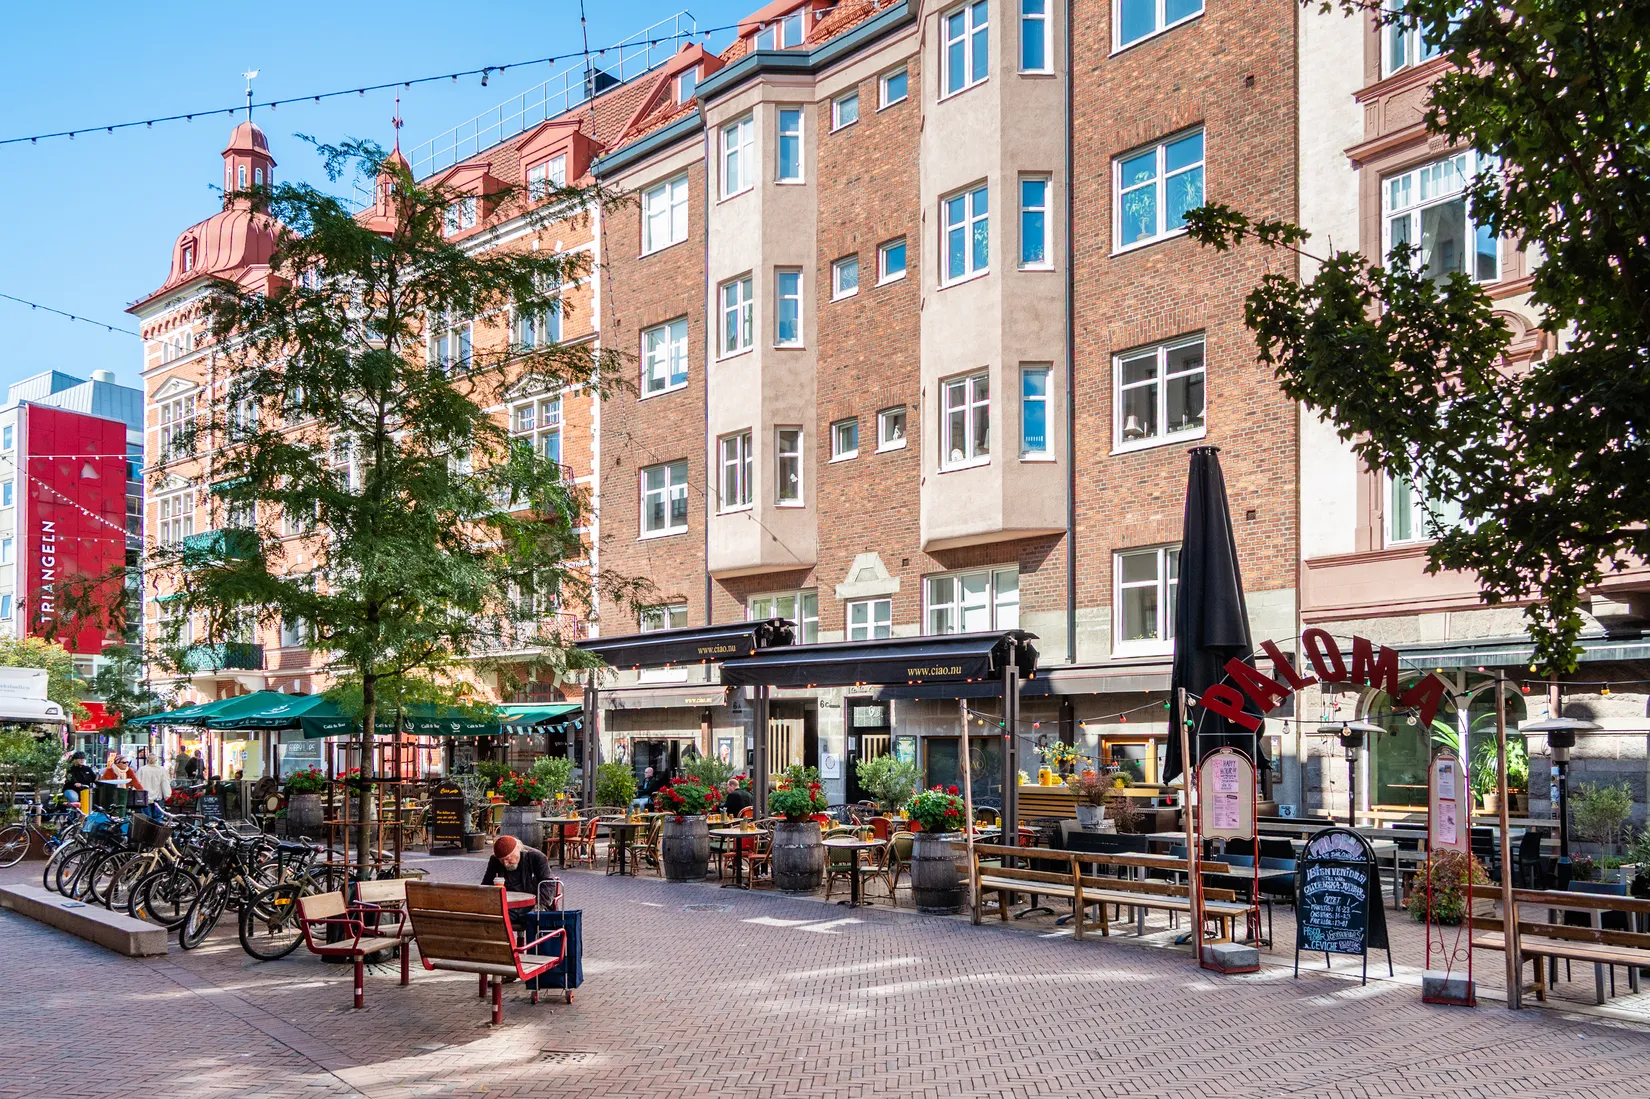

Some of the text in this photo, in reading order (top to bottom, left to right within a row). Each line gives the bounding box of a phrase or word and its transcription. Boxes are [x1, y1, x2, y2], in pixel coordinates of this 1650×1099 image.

[41, 520, 56, 623] TRIANGELN
[697, 643, 737, 655] www.ciao.nu
[907, 664, 962, 677] www.ciao.nu
[1200, 627, 1446, 732] PALOMA
[1310, 940, 1338, 952] CEVICHE
